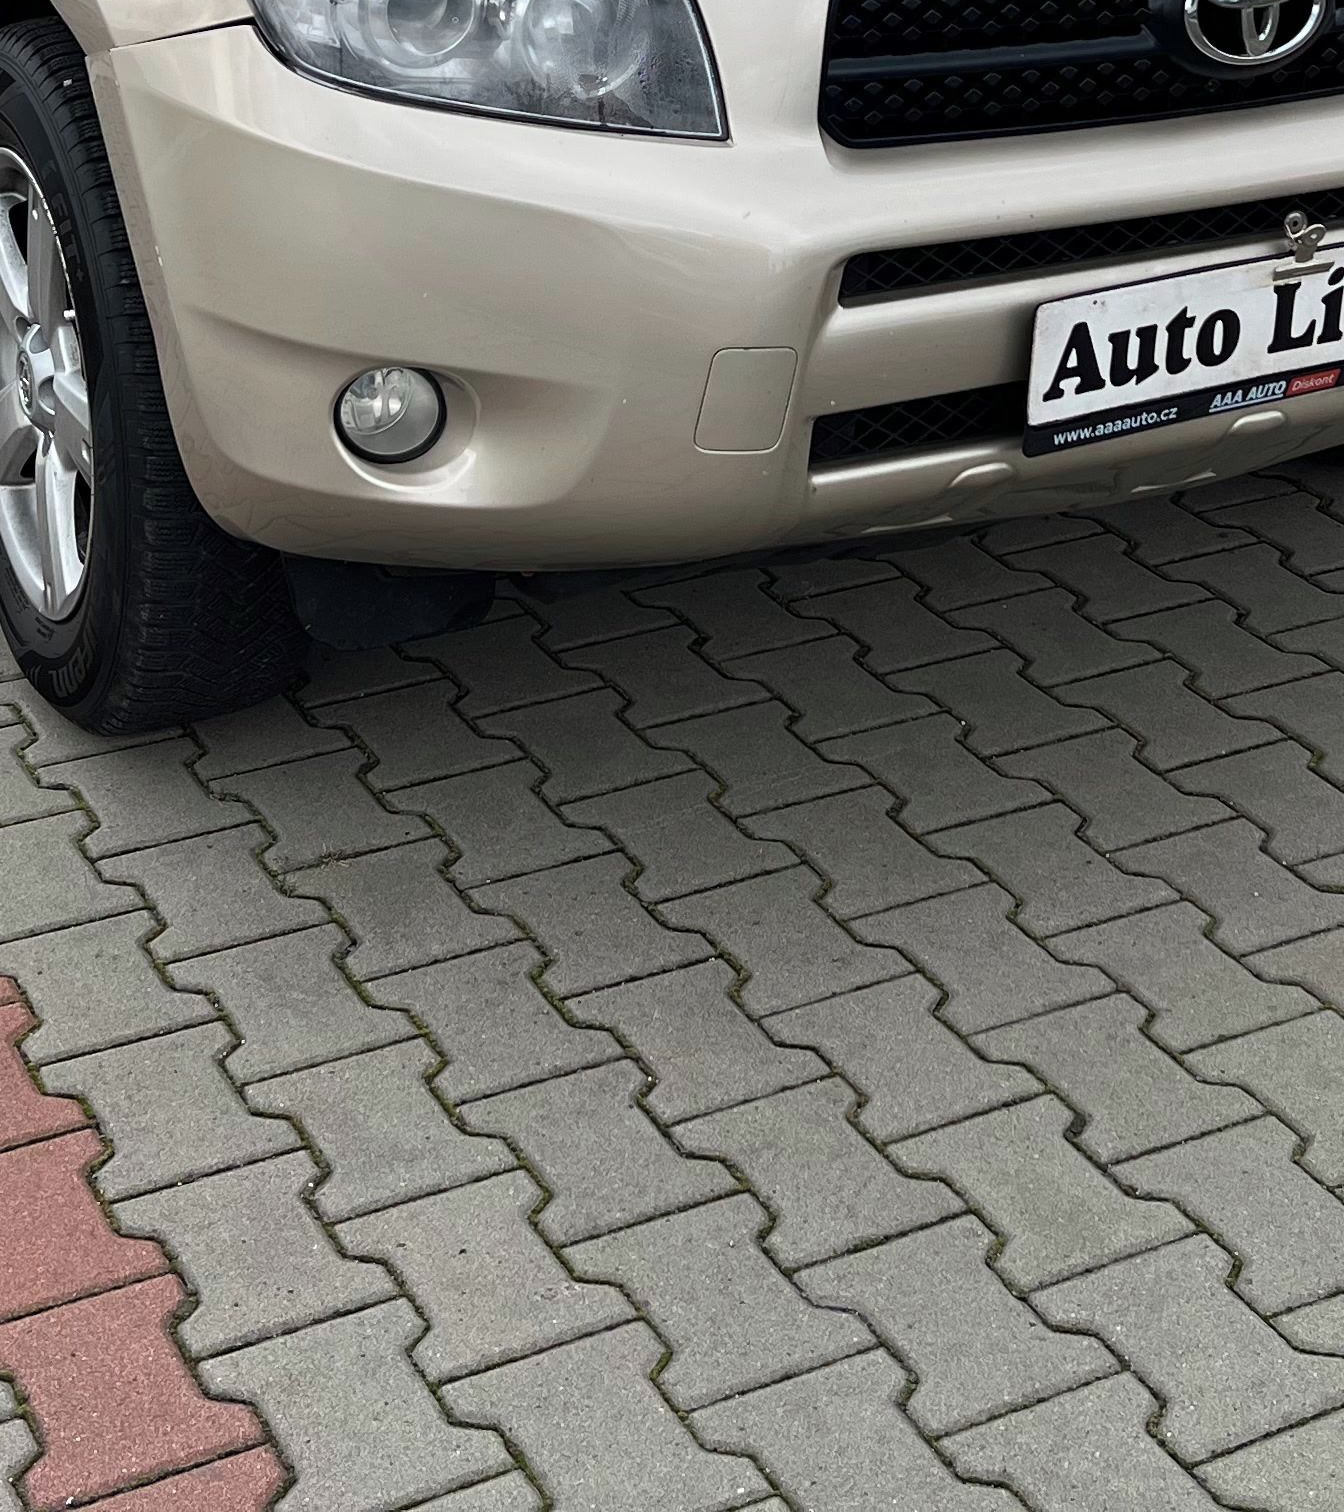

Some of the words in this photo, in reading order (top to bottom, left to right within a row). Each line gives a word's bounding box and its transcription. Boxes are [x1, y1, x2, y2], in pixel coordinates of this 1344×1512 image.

[1042, 305, 1241, 403] Auto
[1209, 393, 1244, 410] AAA
[1245, 380, 1287, 403] AUTO
[1291, 373, 1336, 392] Diskont
[1052, 406, 1178, 446] www.aaaauto.cz
